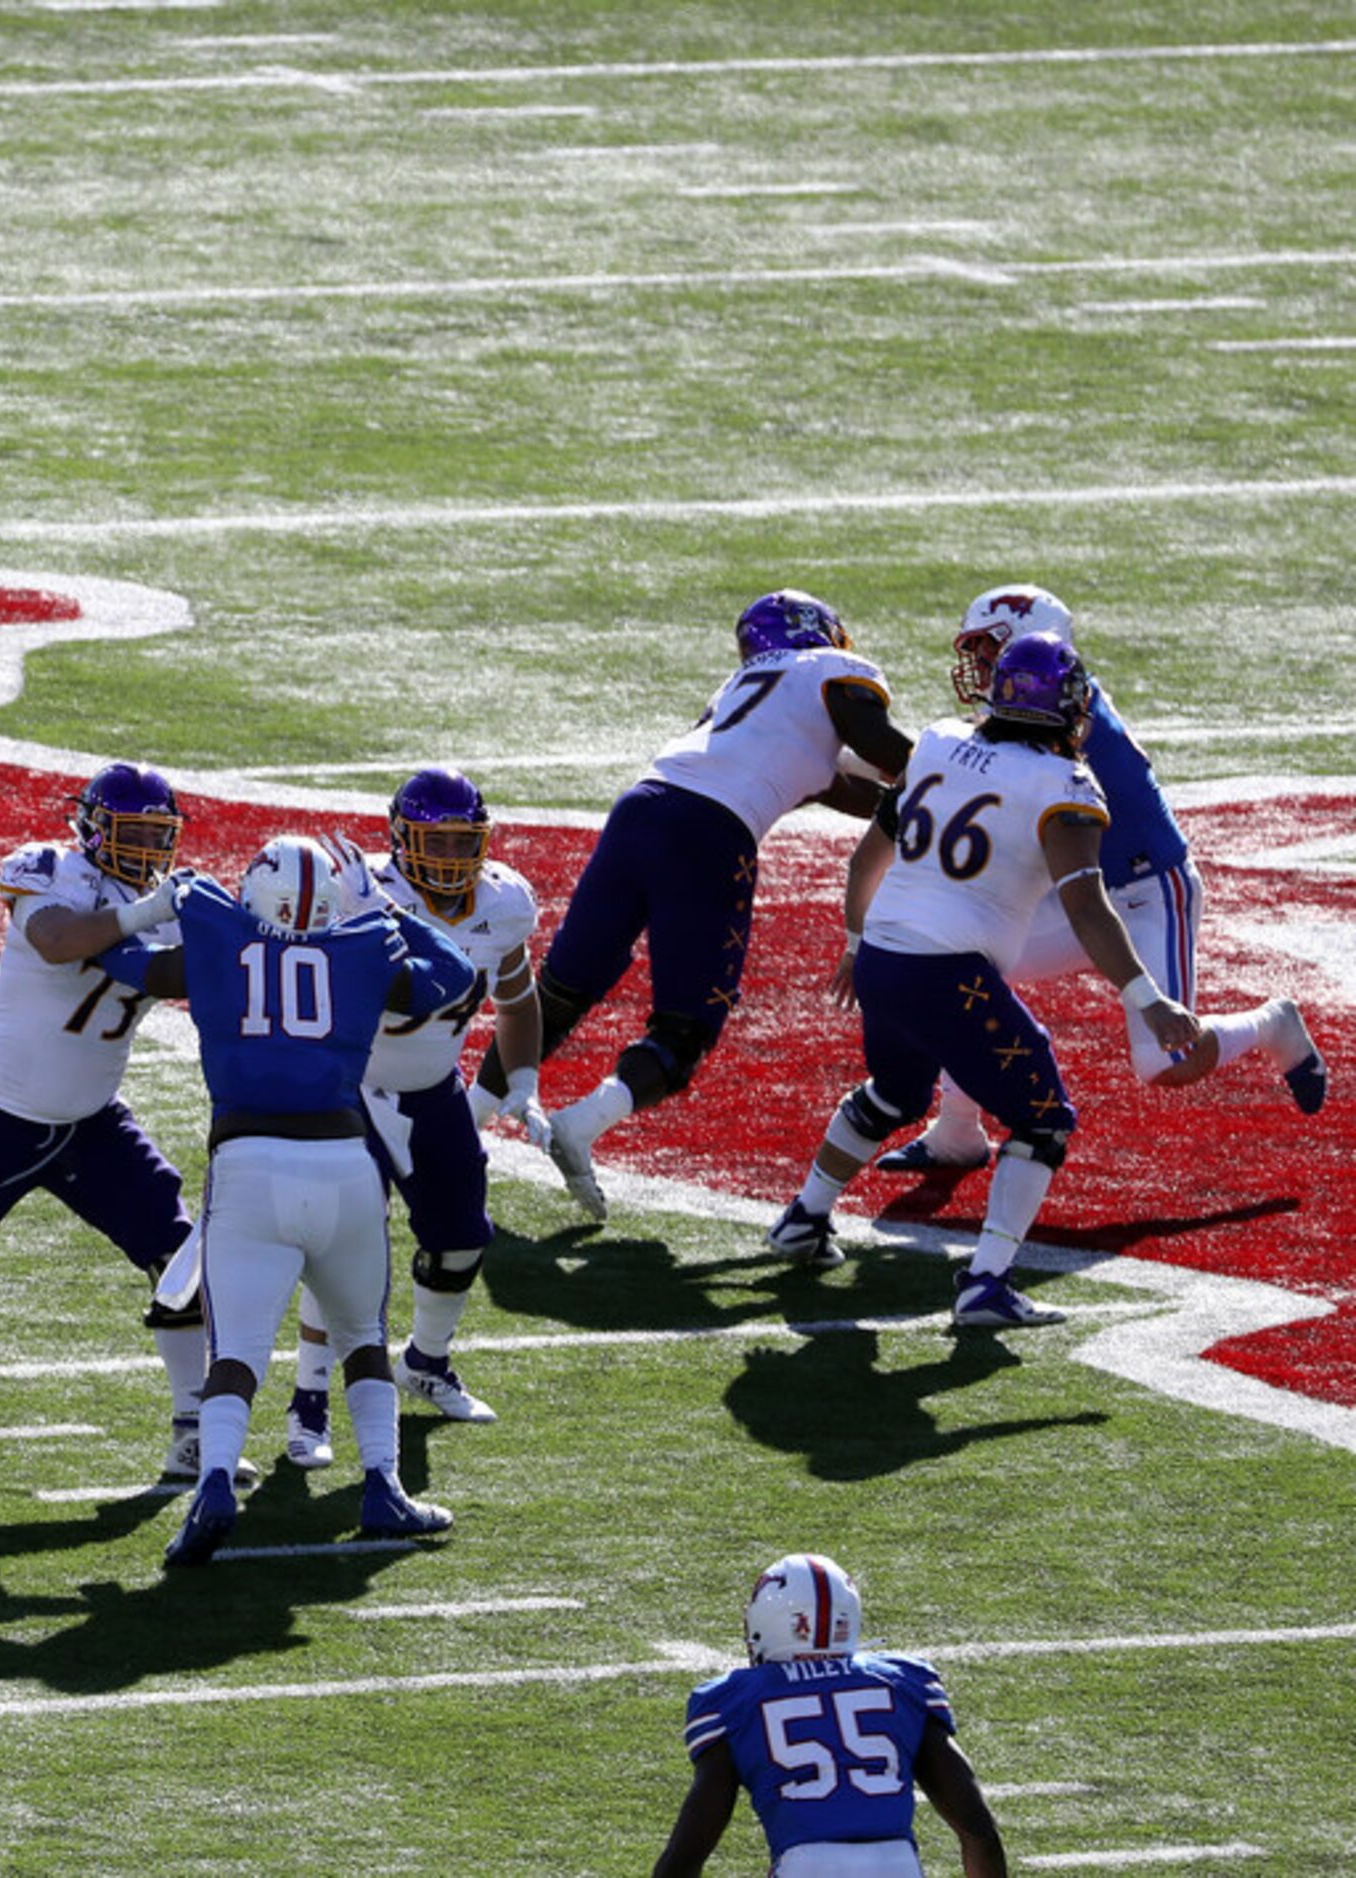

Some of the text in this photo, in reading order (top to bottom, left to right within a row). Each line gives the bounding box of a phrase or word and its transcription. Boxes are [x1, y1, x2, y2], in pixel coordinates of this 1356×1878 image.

[950, 742, 996, 774] FRYE
[900, 772, 1001, 881] 66
[240, 942, 332, 1039] 10
[781, 1658, 851, 1682] WILEY
[762, 1687, 904, 1799] 55
